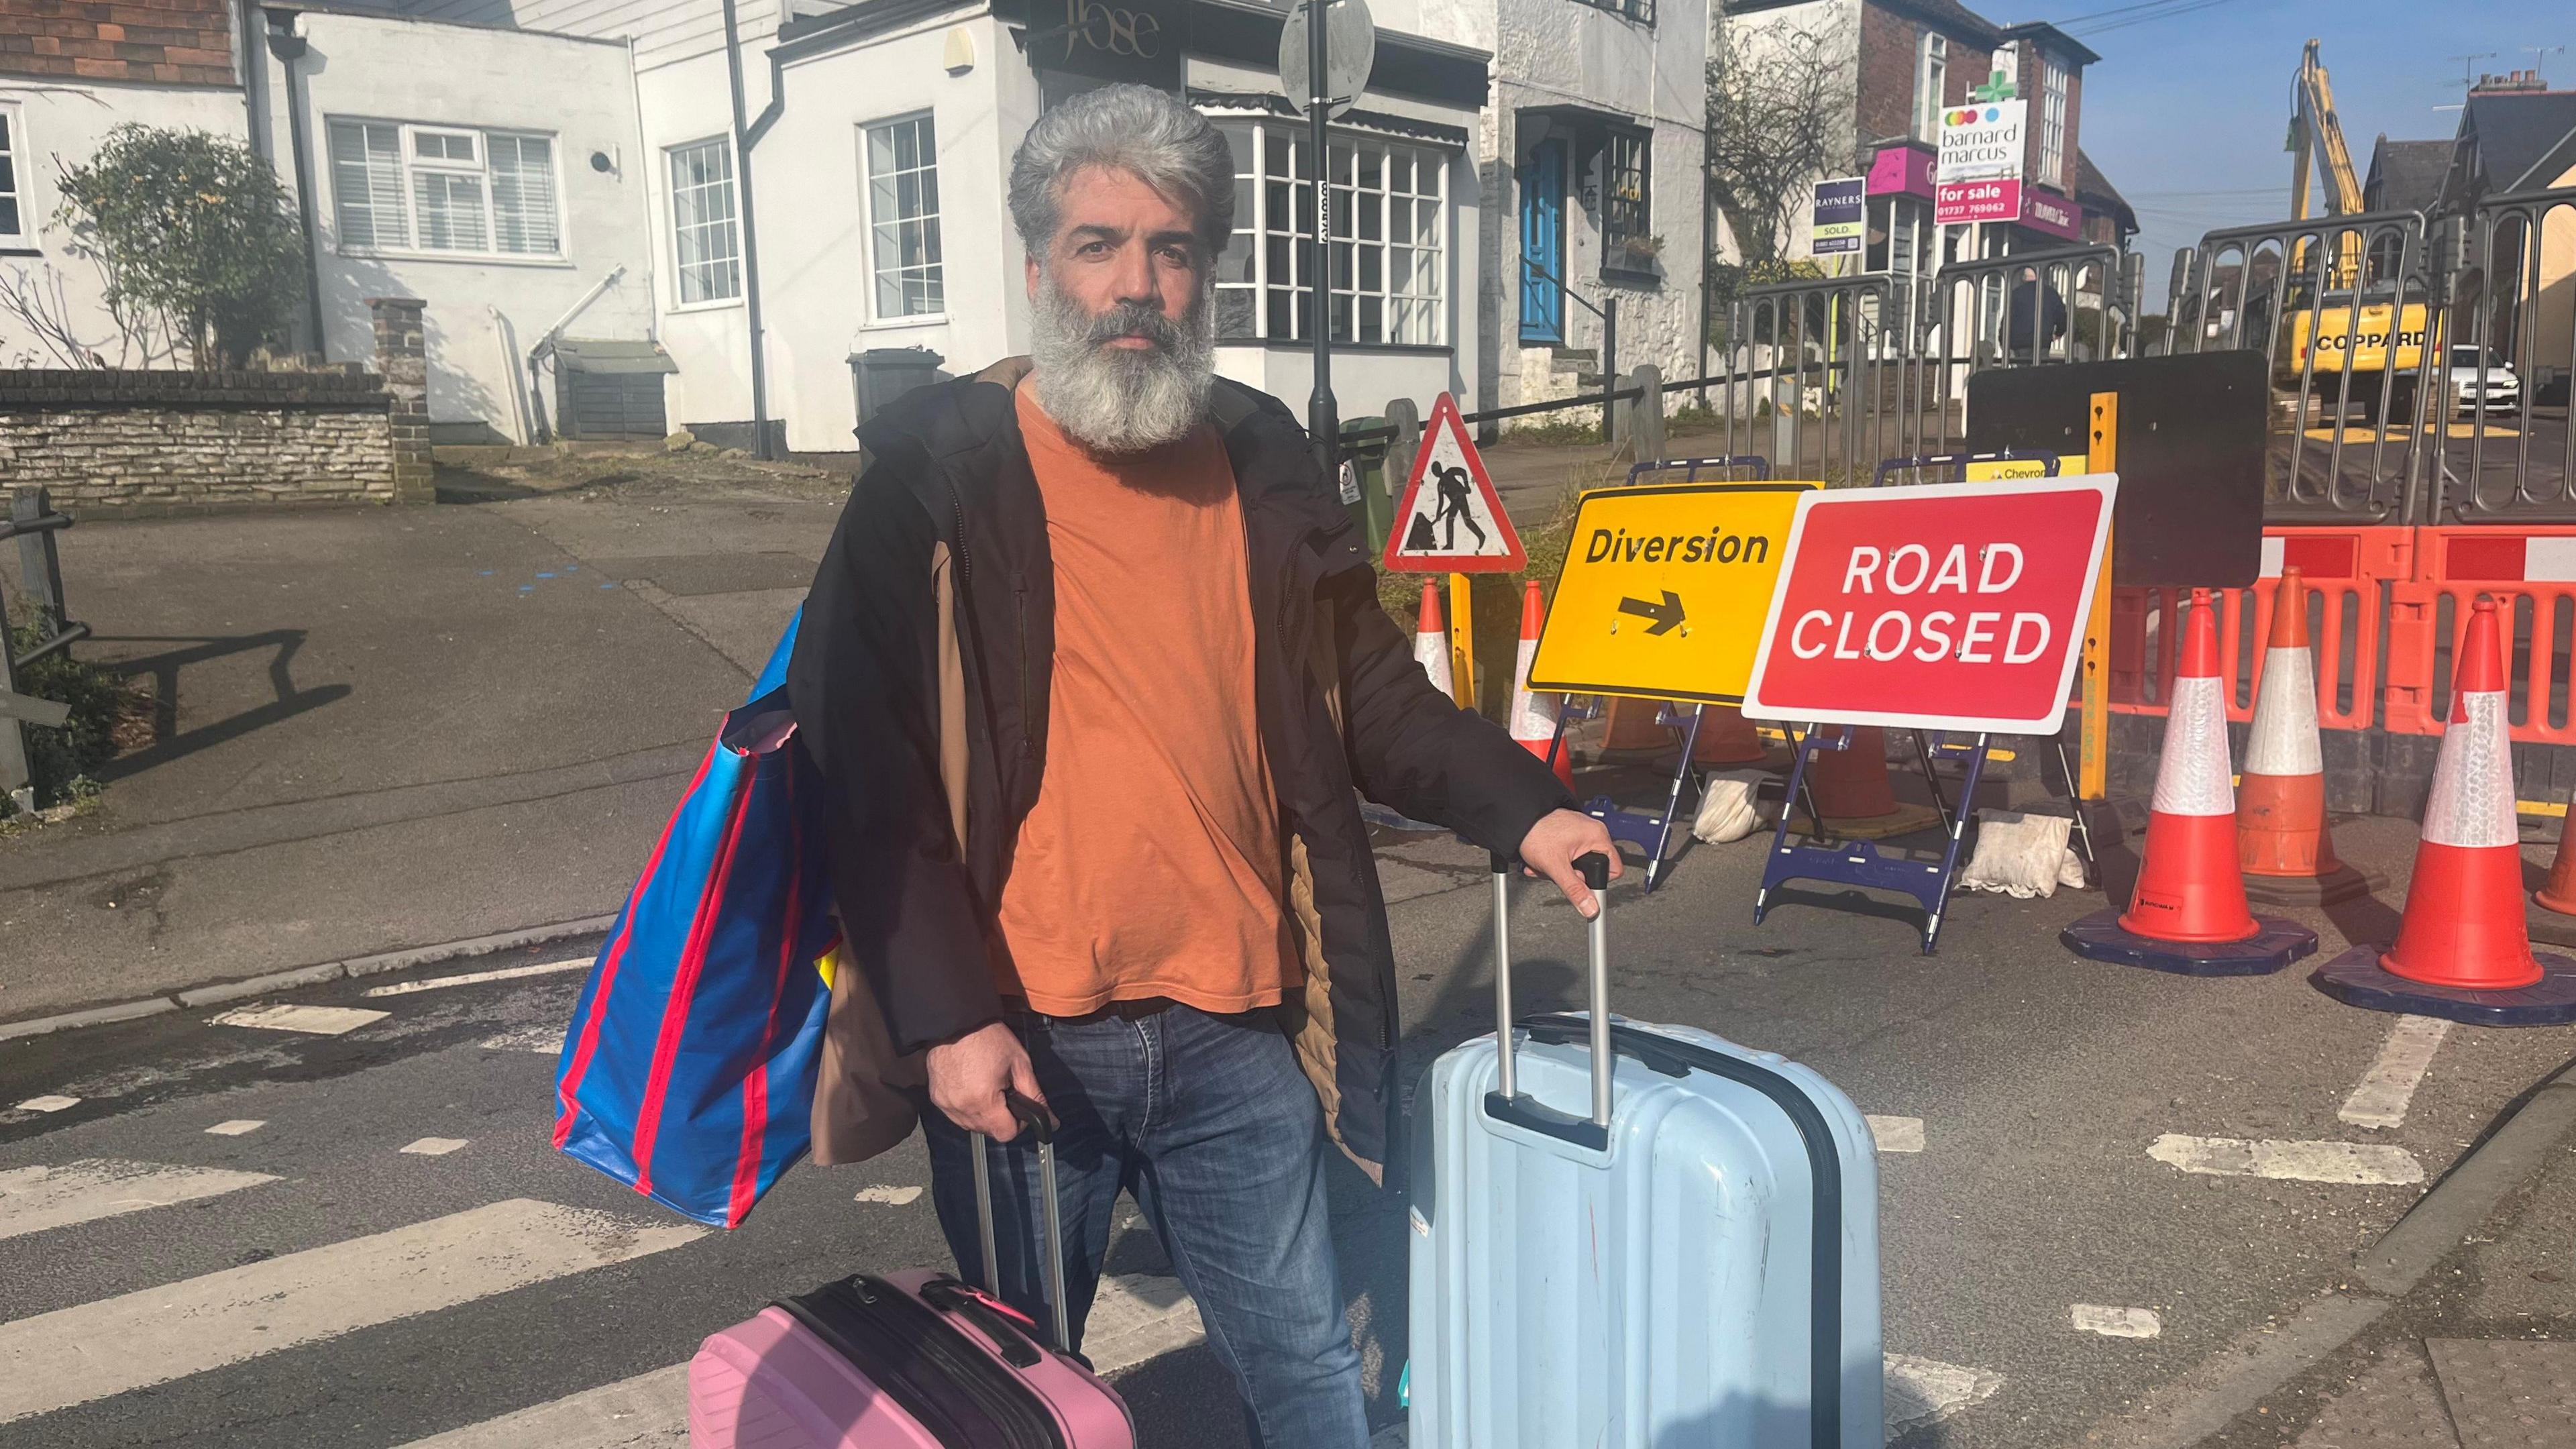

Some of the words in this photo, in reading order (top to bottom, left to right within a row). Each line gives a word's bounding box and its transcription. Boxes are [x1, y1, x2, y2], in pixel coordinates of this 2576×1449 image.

[1943, 123, 2017, 147] barnard
[1942, 146, 2006, 164] marcus
[1816, 195, 1861, 207] RAYNERS
[1939, 188, 1964, 202] for
[1968, 184, 2001, 200] sale
[1937, 206, 1964, 215] 01737
[2316, 331, 2426, 351] COPPARD
[1586, 526, 1769, 564] Diversion
[1841, 542, 2024, 595] ROAD
[1790, 609, 2051, 664] CLOSED
